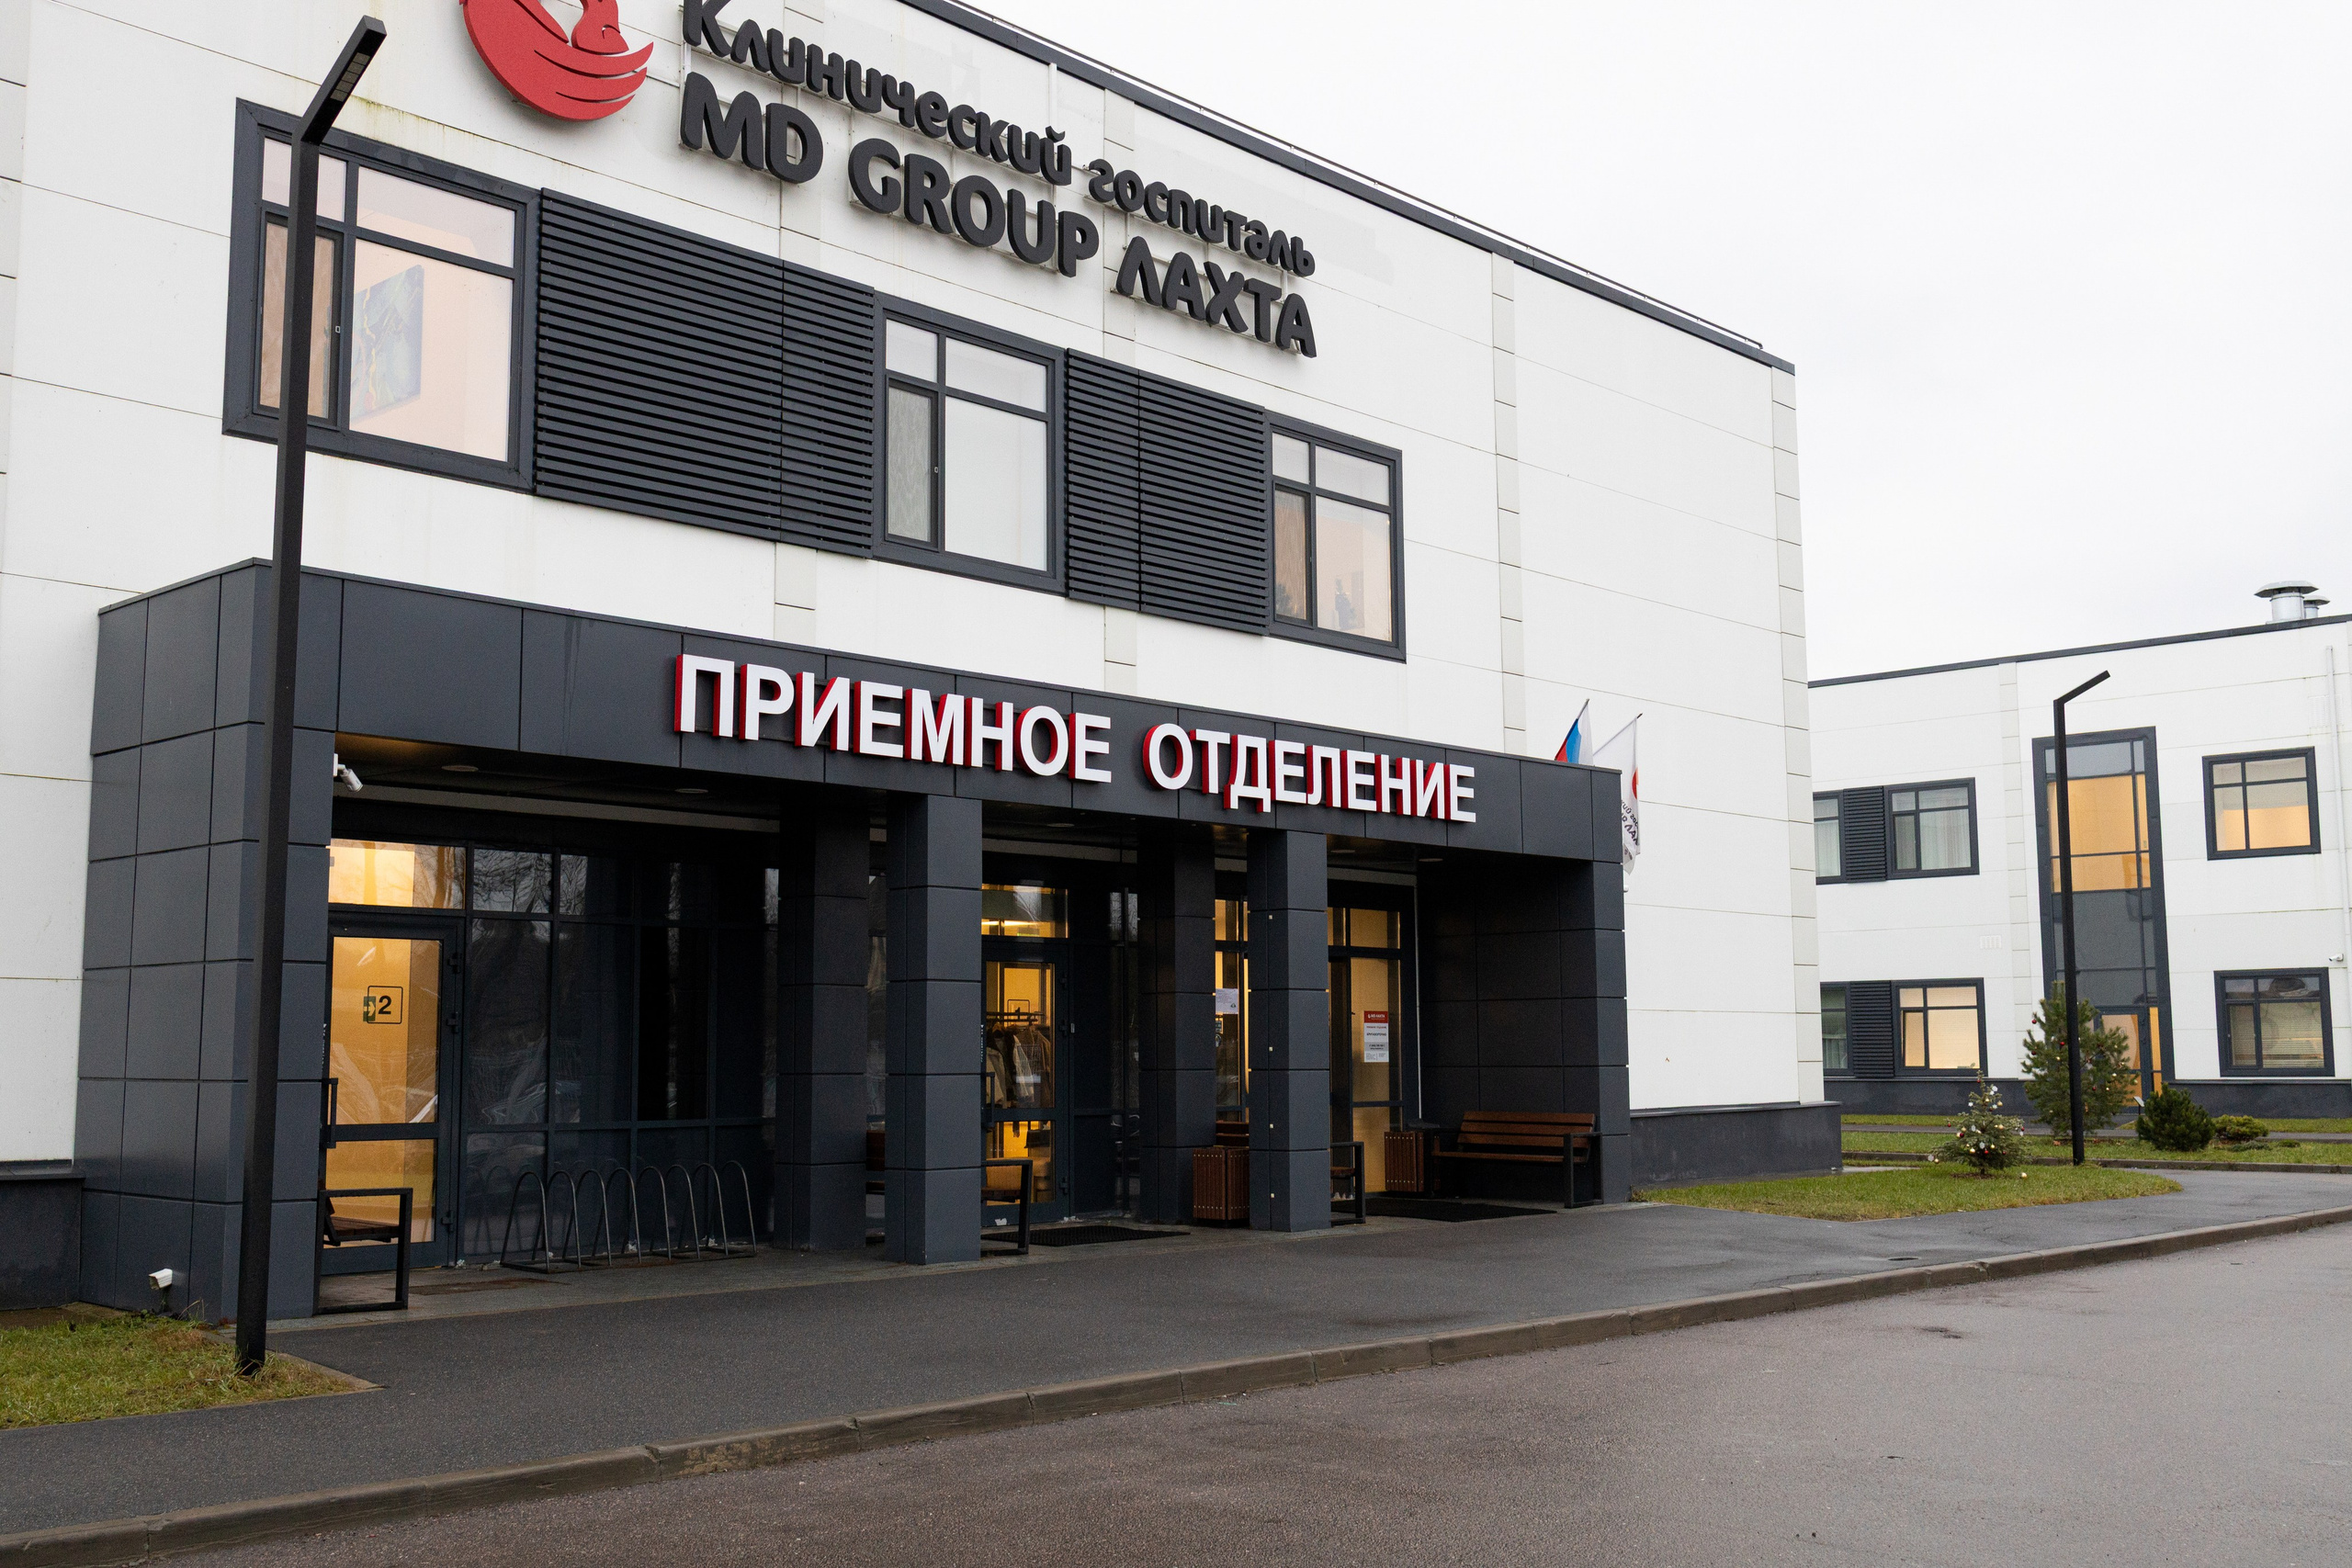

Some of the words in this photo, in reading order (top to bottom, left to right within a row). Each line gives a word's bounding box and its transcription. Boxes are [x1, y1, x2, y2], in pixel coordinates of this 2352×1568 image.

[680, 72, 824, 184] MD
[848, 138, 1100, 277] GROUP
[1114, 235, 1317, 358] ЛАХТА
[683, 0, 1072, 186] Клинический
[1088, 158, 1316, 277] госпиталь
[673, 653, 1113, 784] ПРИЕМНОЕ
[1142, 722, 1476, 824] ОТДЕЛЕНИЕ
[378, 995, 392, 1015] 2
